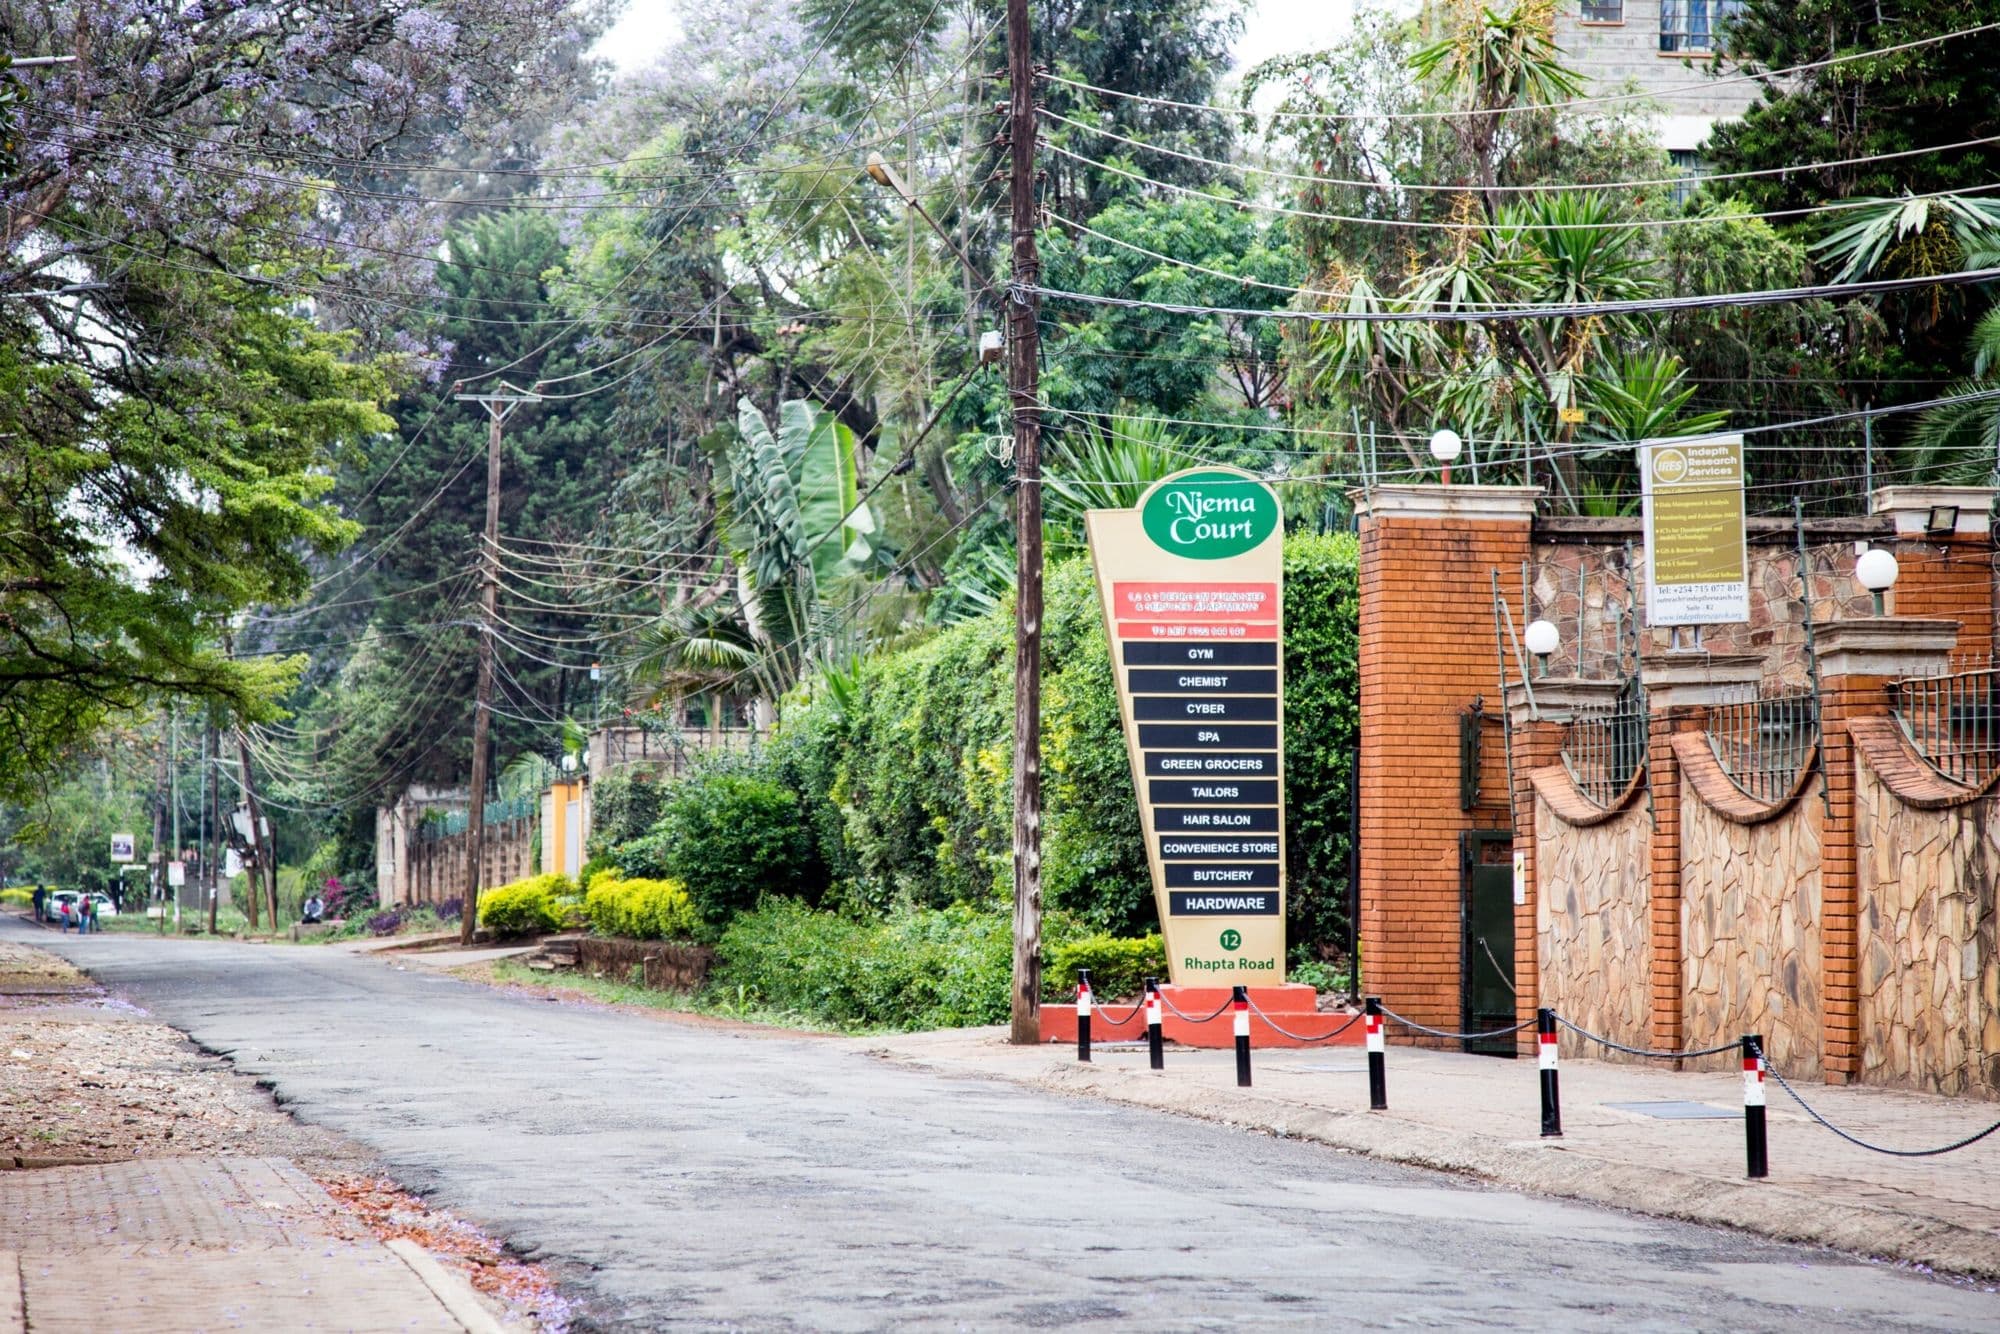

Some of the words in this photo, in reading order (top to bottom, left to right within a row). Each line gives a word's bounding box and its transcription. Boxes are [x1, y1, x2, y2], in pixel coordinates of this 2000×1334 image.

[1687, 447, 1729, 457] Indepth
[1688, 456, 1738, 466] Research
[1688, 467, 1733, 476] Services
[1165, 491, 1256, 523] Njema
[1170, 516, 1253, 545] Court
[1188, 650, 1213, 659] GYM
[1179, 677, 1228, 687] CHEMIST
[1187, 704, 1225, 714] CYBER
[1198, 732, 1220, 742] SPA
[1161, 760, 1202, 770] GREEN
[1205, 760, 1263, 770] GROCERS
[1192, 788, 1239, 797] TAILORS
[1183, 816, 1210, 825] HAIR
[1212, 816, 1251, 825] SALON
[1163, 844, 1240, 853] CONVENIENCE
[1242, 844, 1278, 853] STORE
[1193, 871, 1253, 880] BUTCHERY
[1186, 898, 1265, 909] HARDWARE
[1223, 934, 1239, 946] 12
[1185, 958, 1235, 972] Rhapta
[1239, 958, 1274, 970] Road
